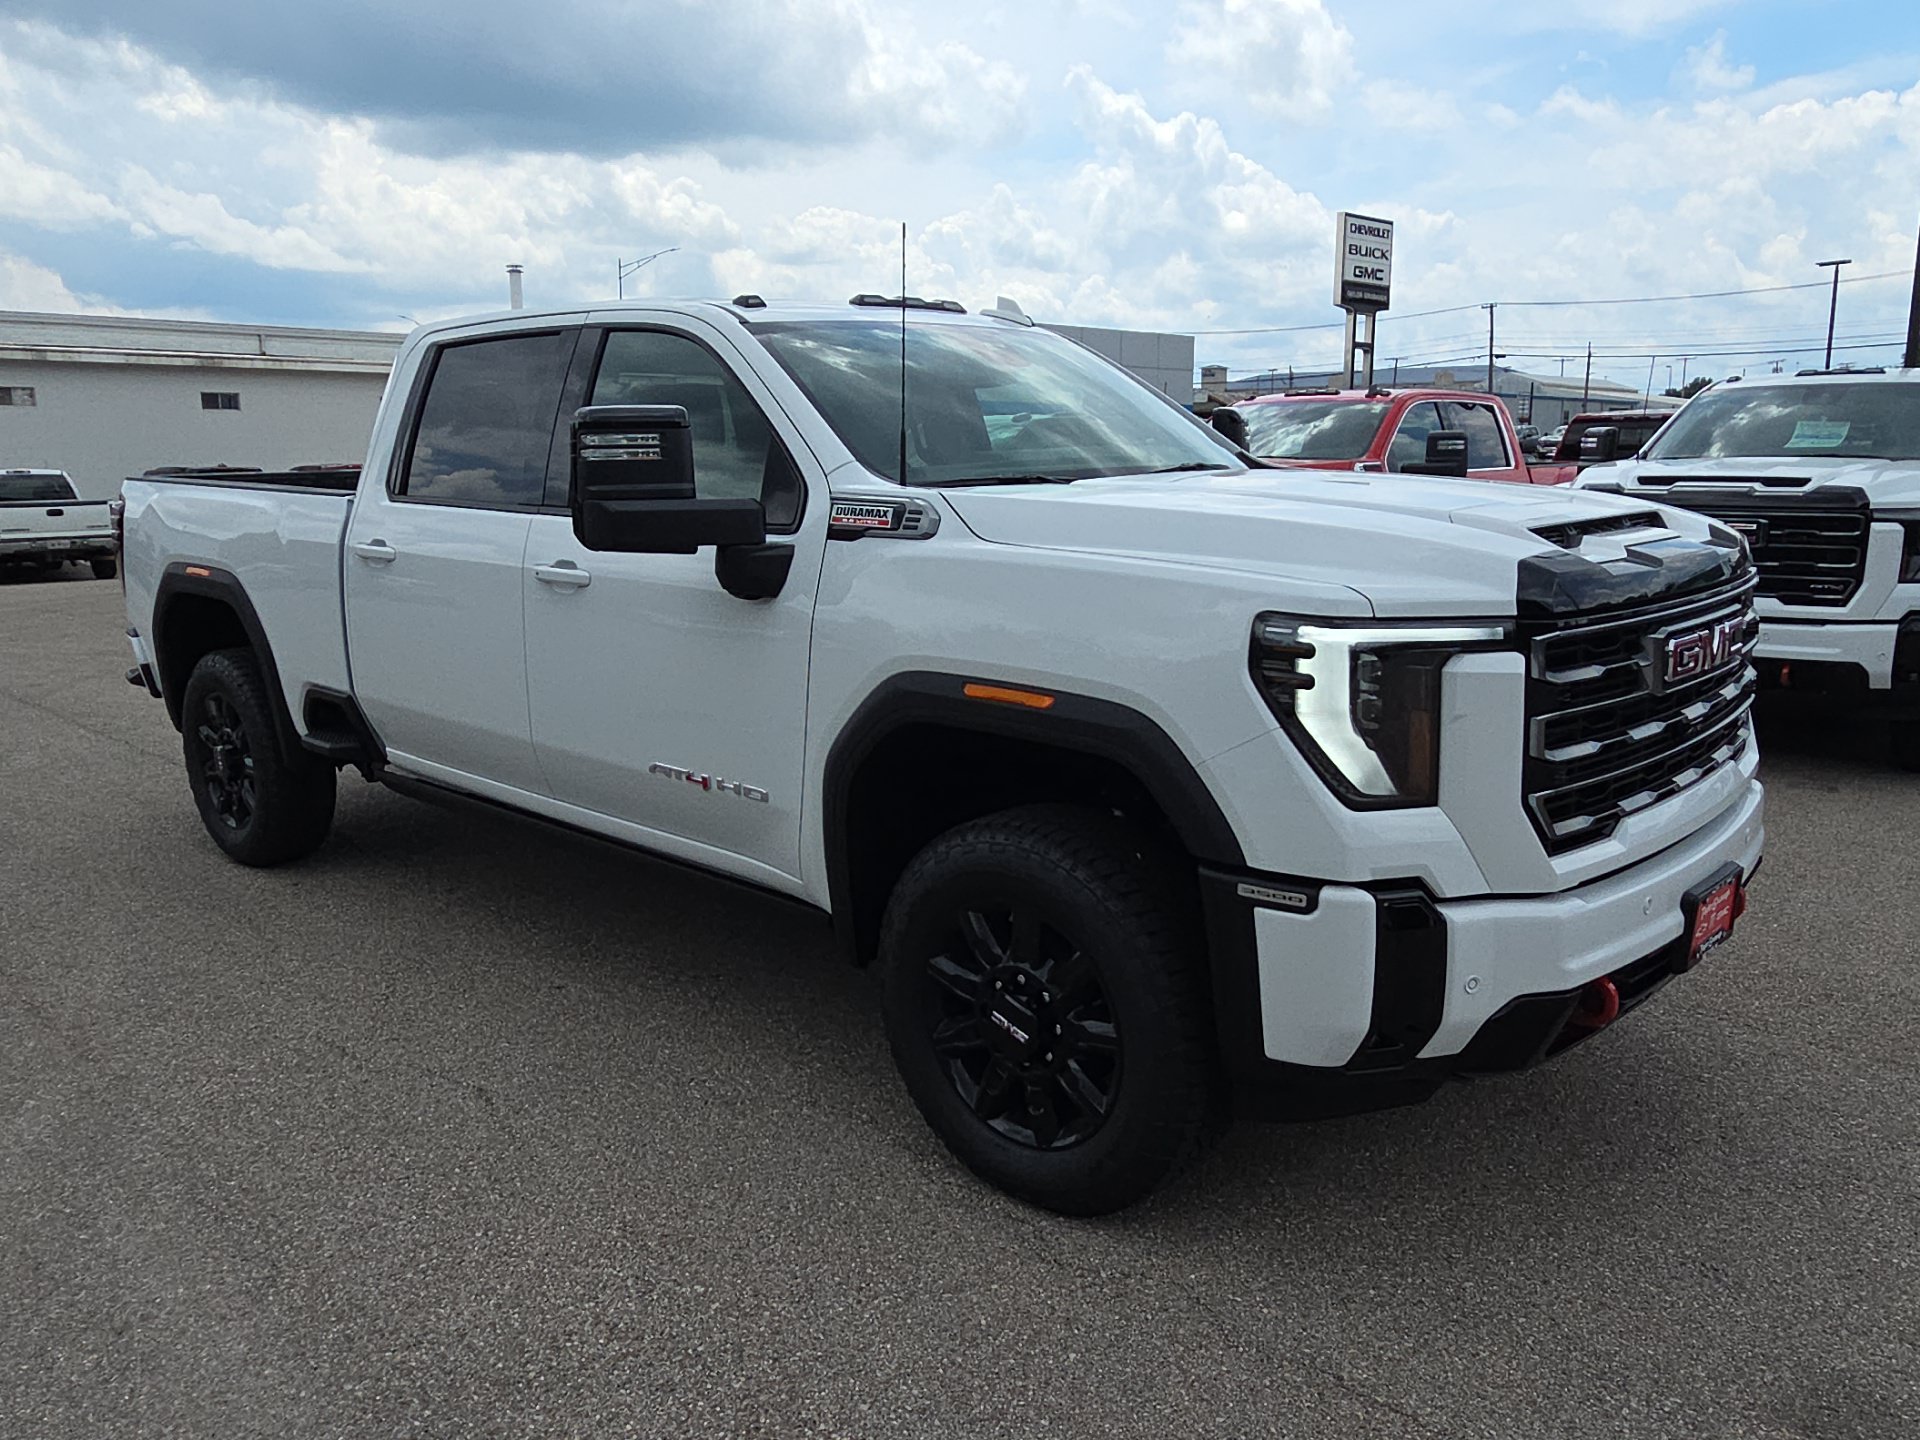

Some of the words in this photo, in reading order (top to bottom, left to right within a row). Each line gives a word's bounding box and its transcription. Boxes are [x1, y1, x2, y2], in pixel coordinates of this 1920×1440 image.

[1349, 223, 1390, 239] CHEVROLET
[1348, 243, 1389, 261] BUICK
[1353, 265, 1385, 281] GMC
[835, 507, 890, 519] DURAMAX
[1664, 616, 1745, 682] GMC
[648, 762, 712, 792] AT4
[716, 777, 769, 803] HD
